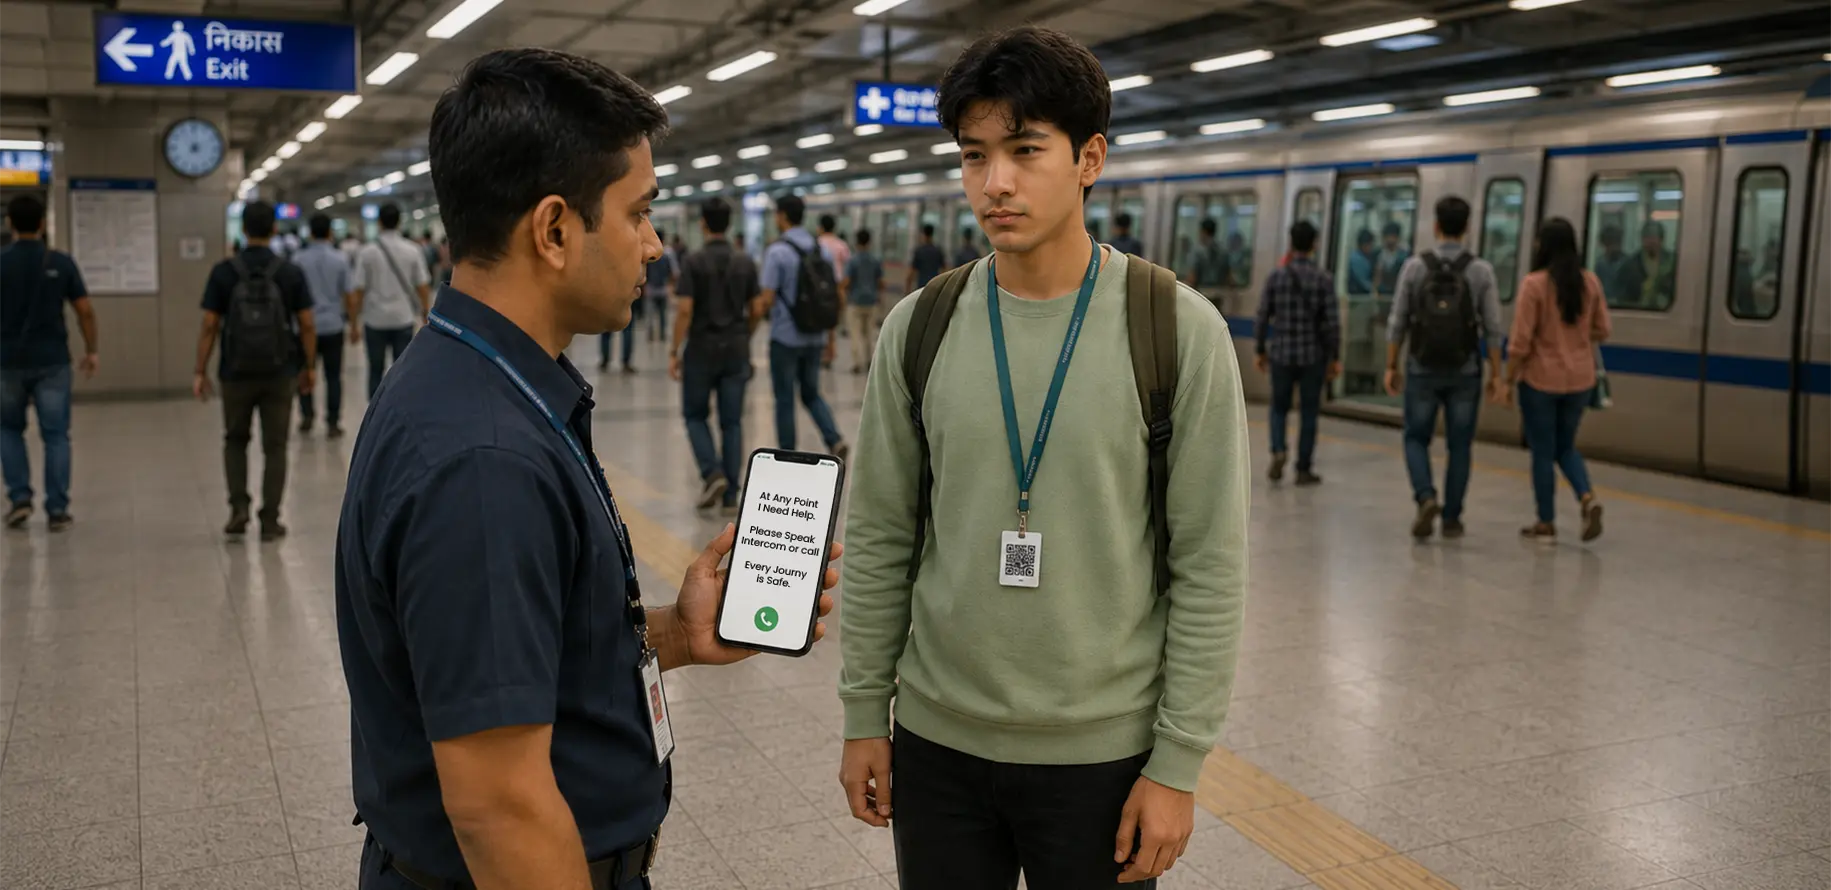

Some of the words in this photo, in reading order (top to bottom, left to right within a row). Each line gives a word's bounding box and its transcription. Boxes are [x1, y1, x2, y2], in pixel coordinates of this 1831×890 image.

[204, 20, 284, 54] निकास
[205, 57, 249, 81] Exit
[759, 491, 771, 501] At
[772, 493, 793, 506] Any
[793, 496, 819, 509] Point
[762, 503, 789, 516] Need
[791, 508, 816, 521] Help.
[749, 525, 783, 539] Please
[784, 531, 816, 544] Speak
[741, 536, 787, 551] Intercom
[788, 543, 799, 553] or
[801, 546, 820, 557] call
[744, 560, 772, 574] Every
[772, 565, 808, 580] Journy
[756, 573, 765, 584] is
[766, 576, 791, 588] Safe.
